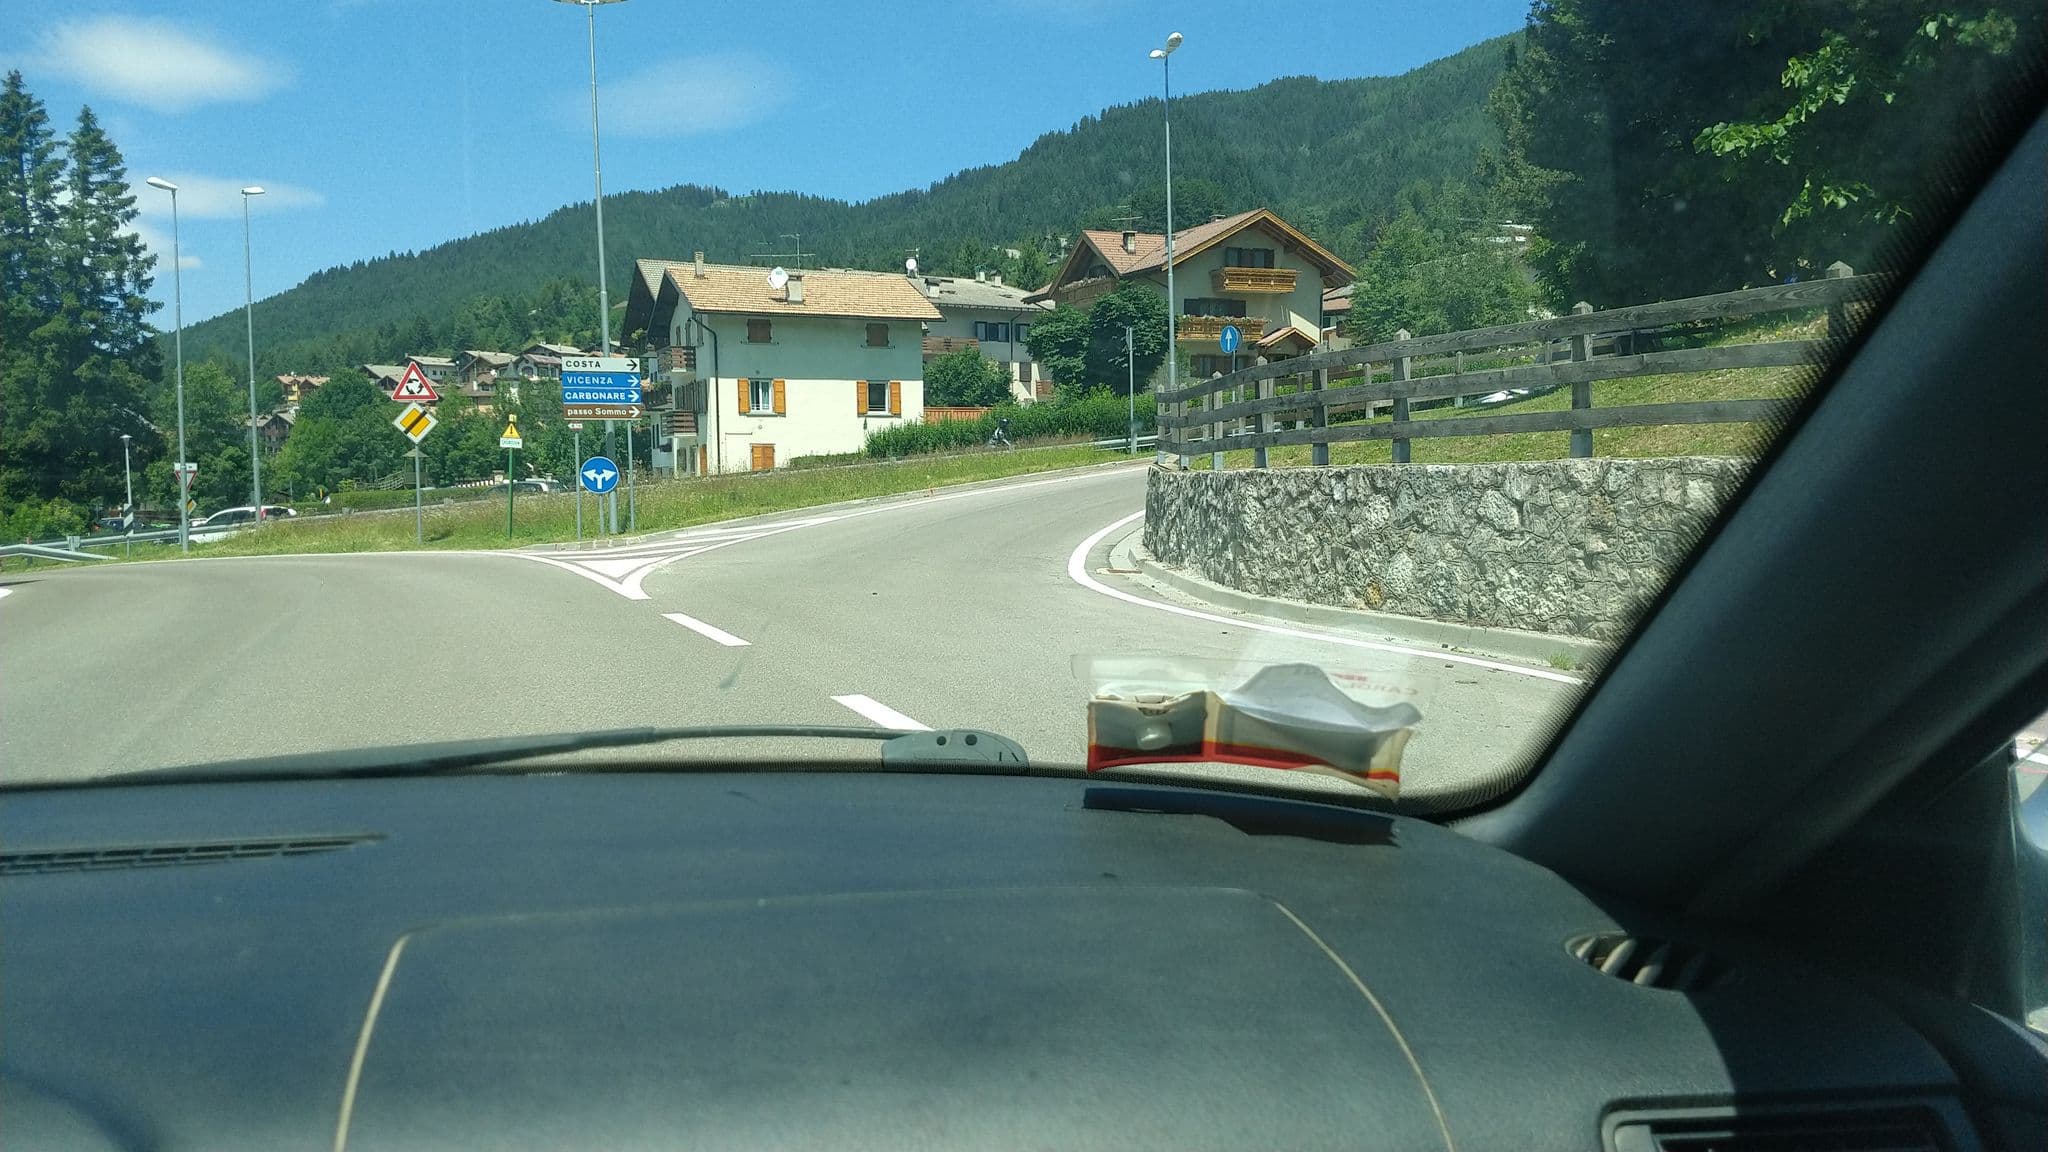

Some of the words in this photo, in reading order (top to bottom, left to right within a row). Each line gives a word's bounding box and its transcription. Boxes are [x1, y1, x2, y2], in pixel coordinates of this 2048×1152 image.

[565, 360, 601, 368] COSTA
[567, 376, 613, 384] VICENZA
[565, 392, 625, 400] CARBONARE
[595, 408, 627, 416] Sommo
